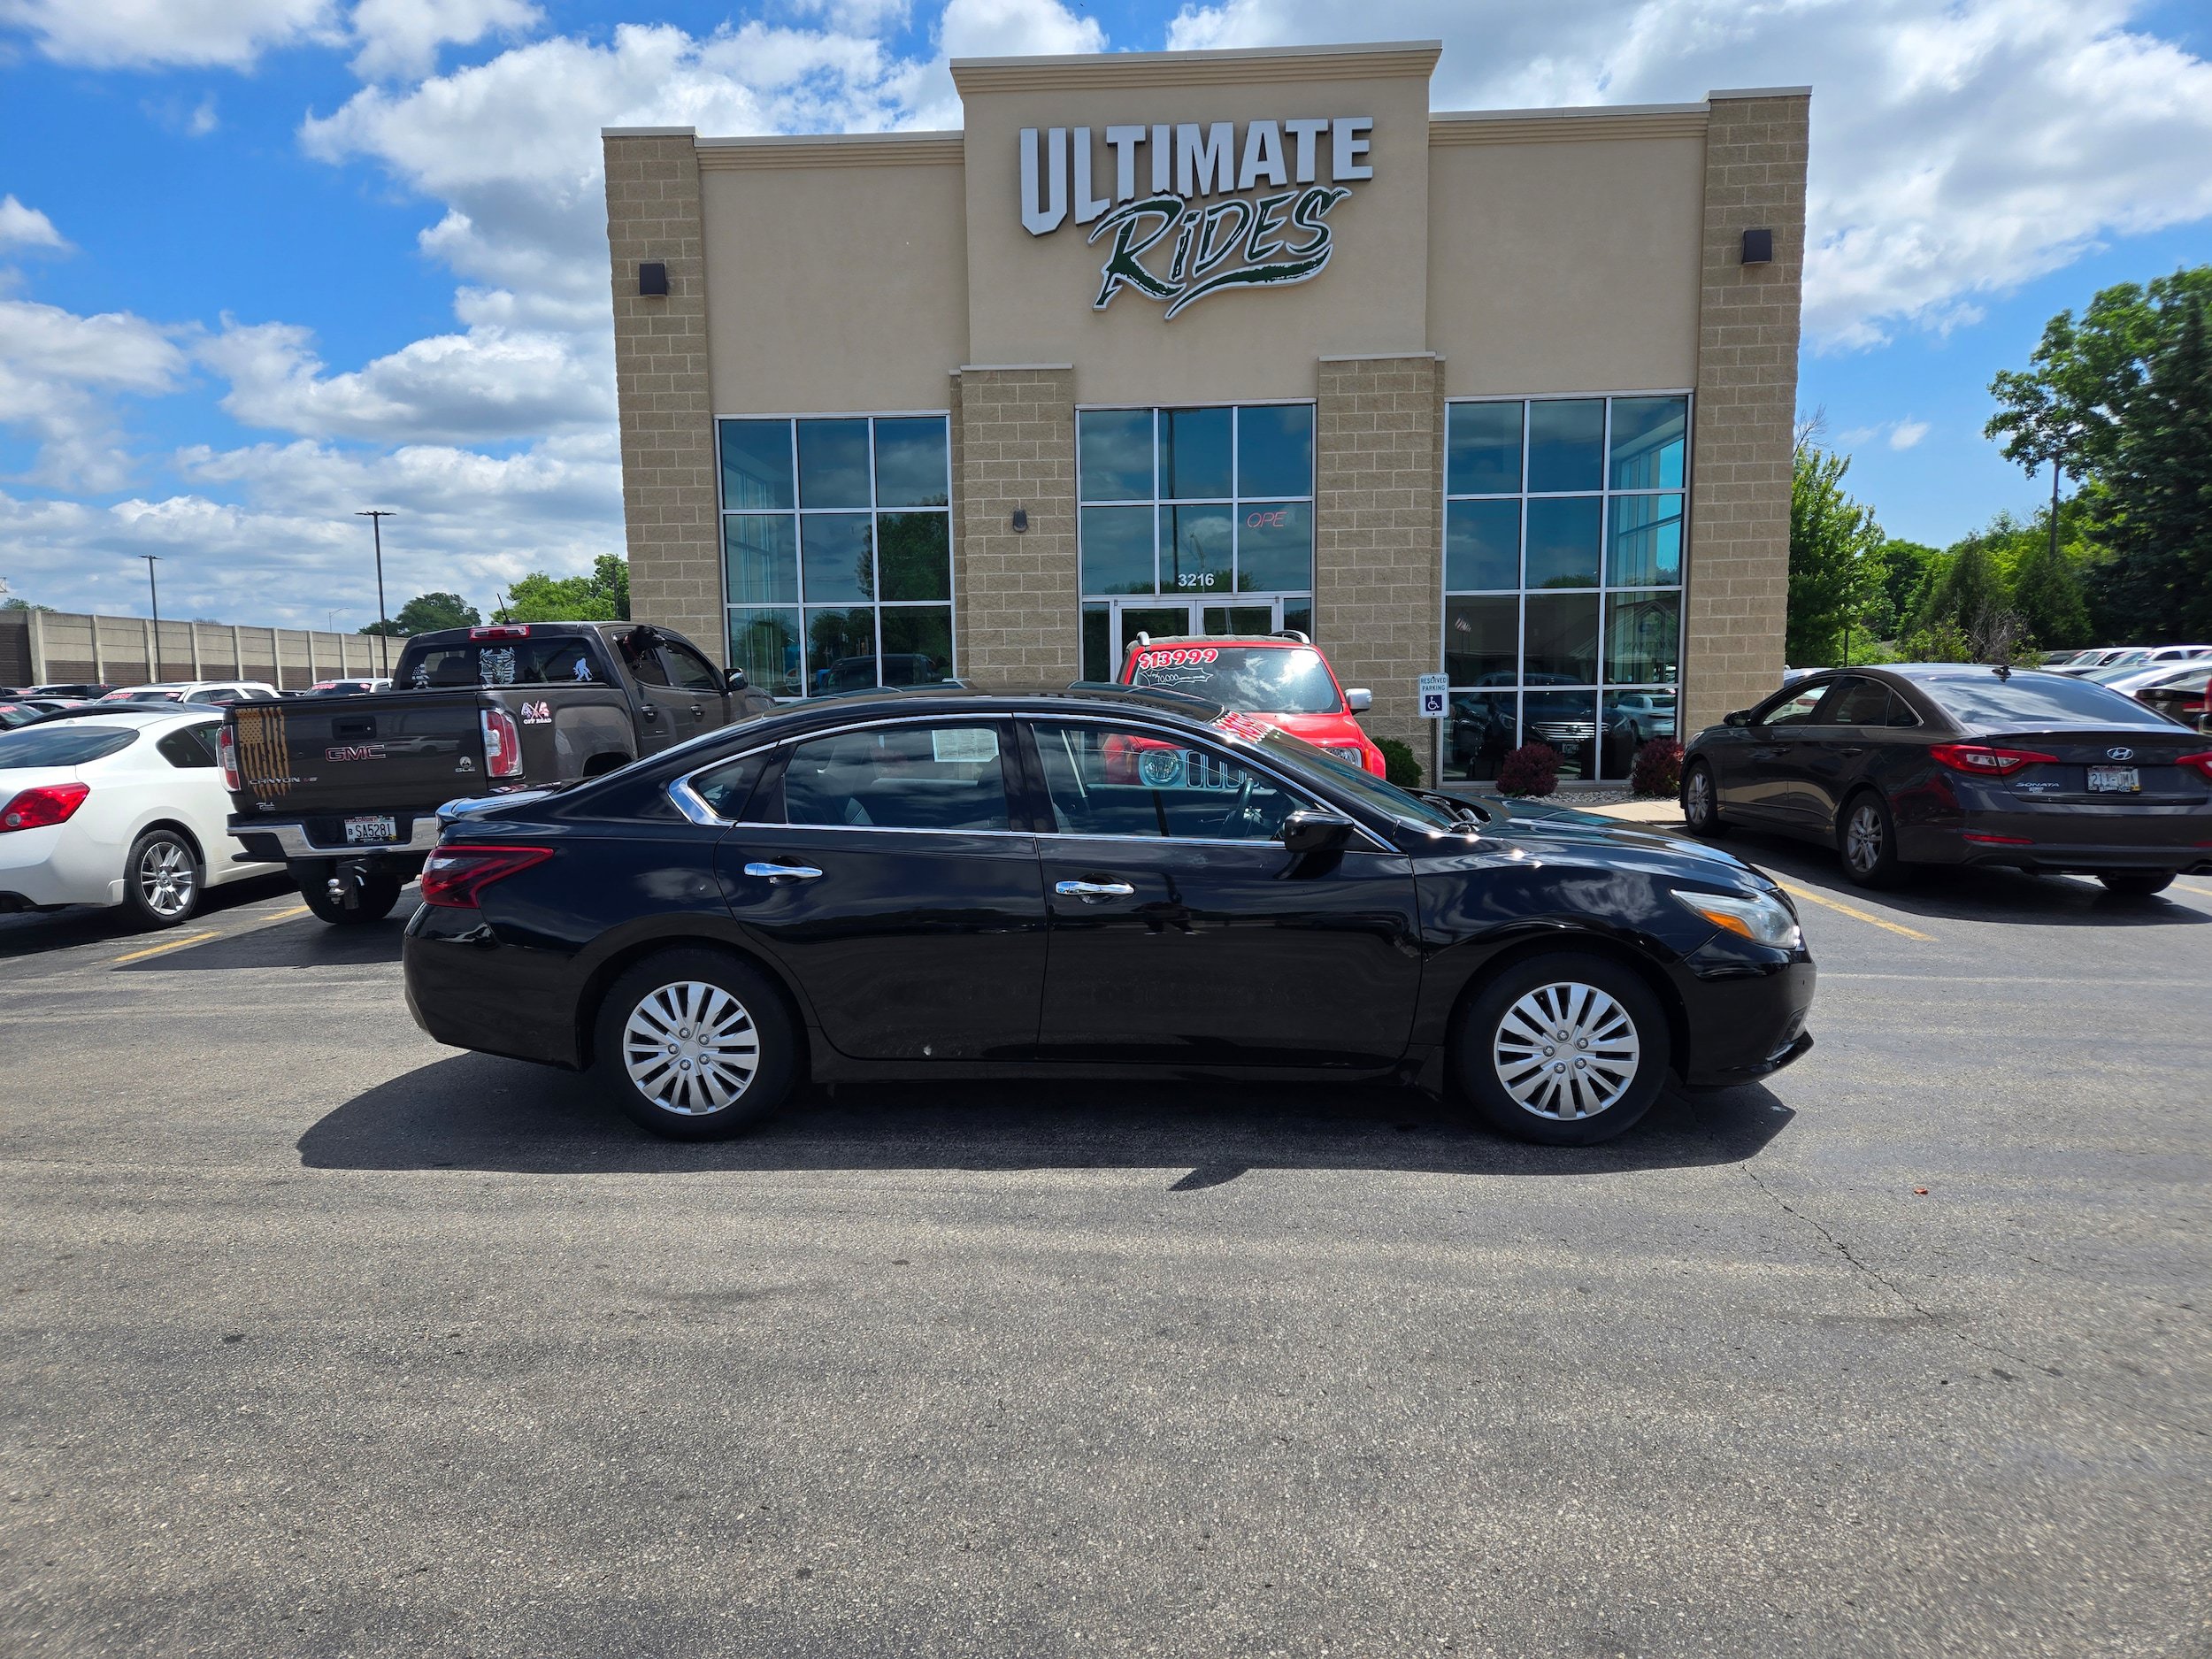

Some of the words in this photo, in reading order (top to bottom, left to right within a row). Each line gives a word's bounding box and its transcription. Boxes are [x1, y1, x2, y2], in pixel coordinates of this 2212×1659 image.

[1019, 116, 1374, 236] ULTIMATE
[1178, 572, 1215, 588] 3216
[1138, 649, 1219, 670] $13999
[326, 744, 387, 762] GMC
[356, 823, 392, 837] SA5281
